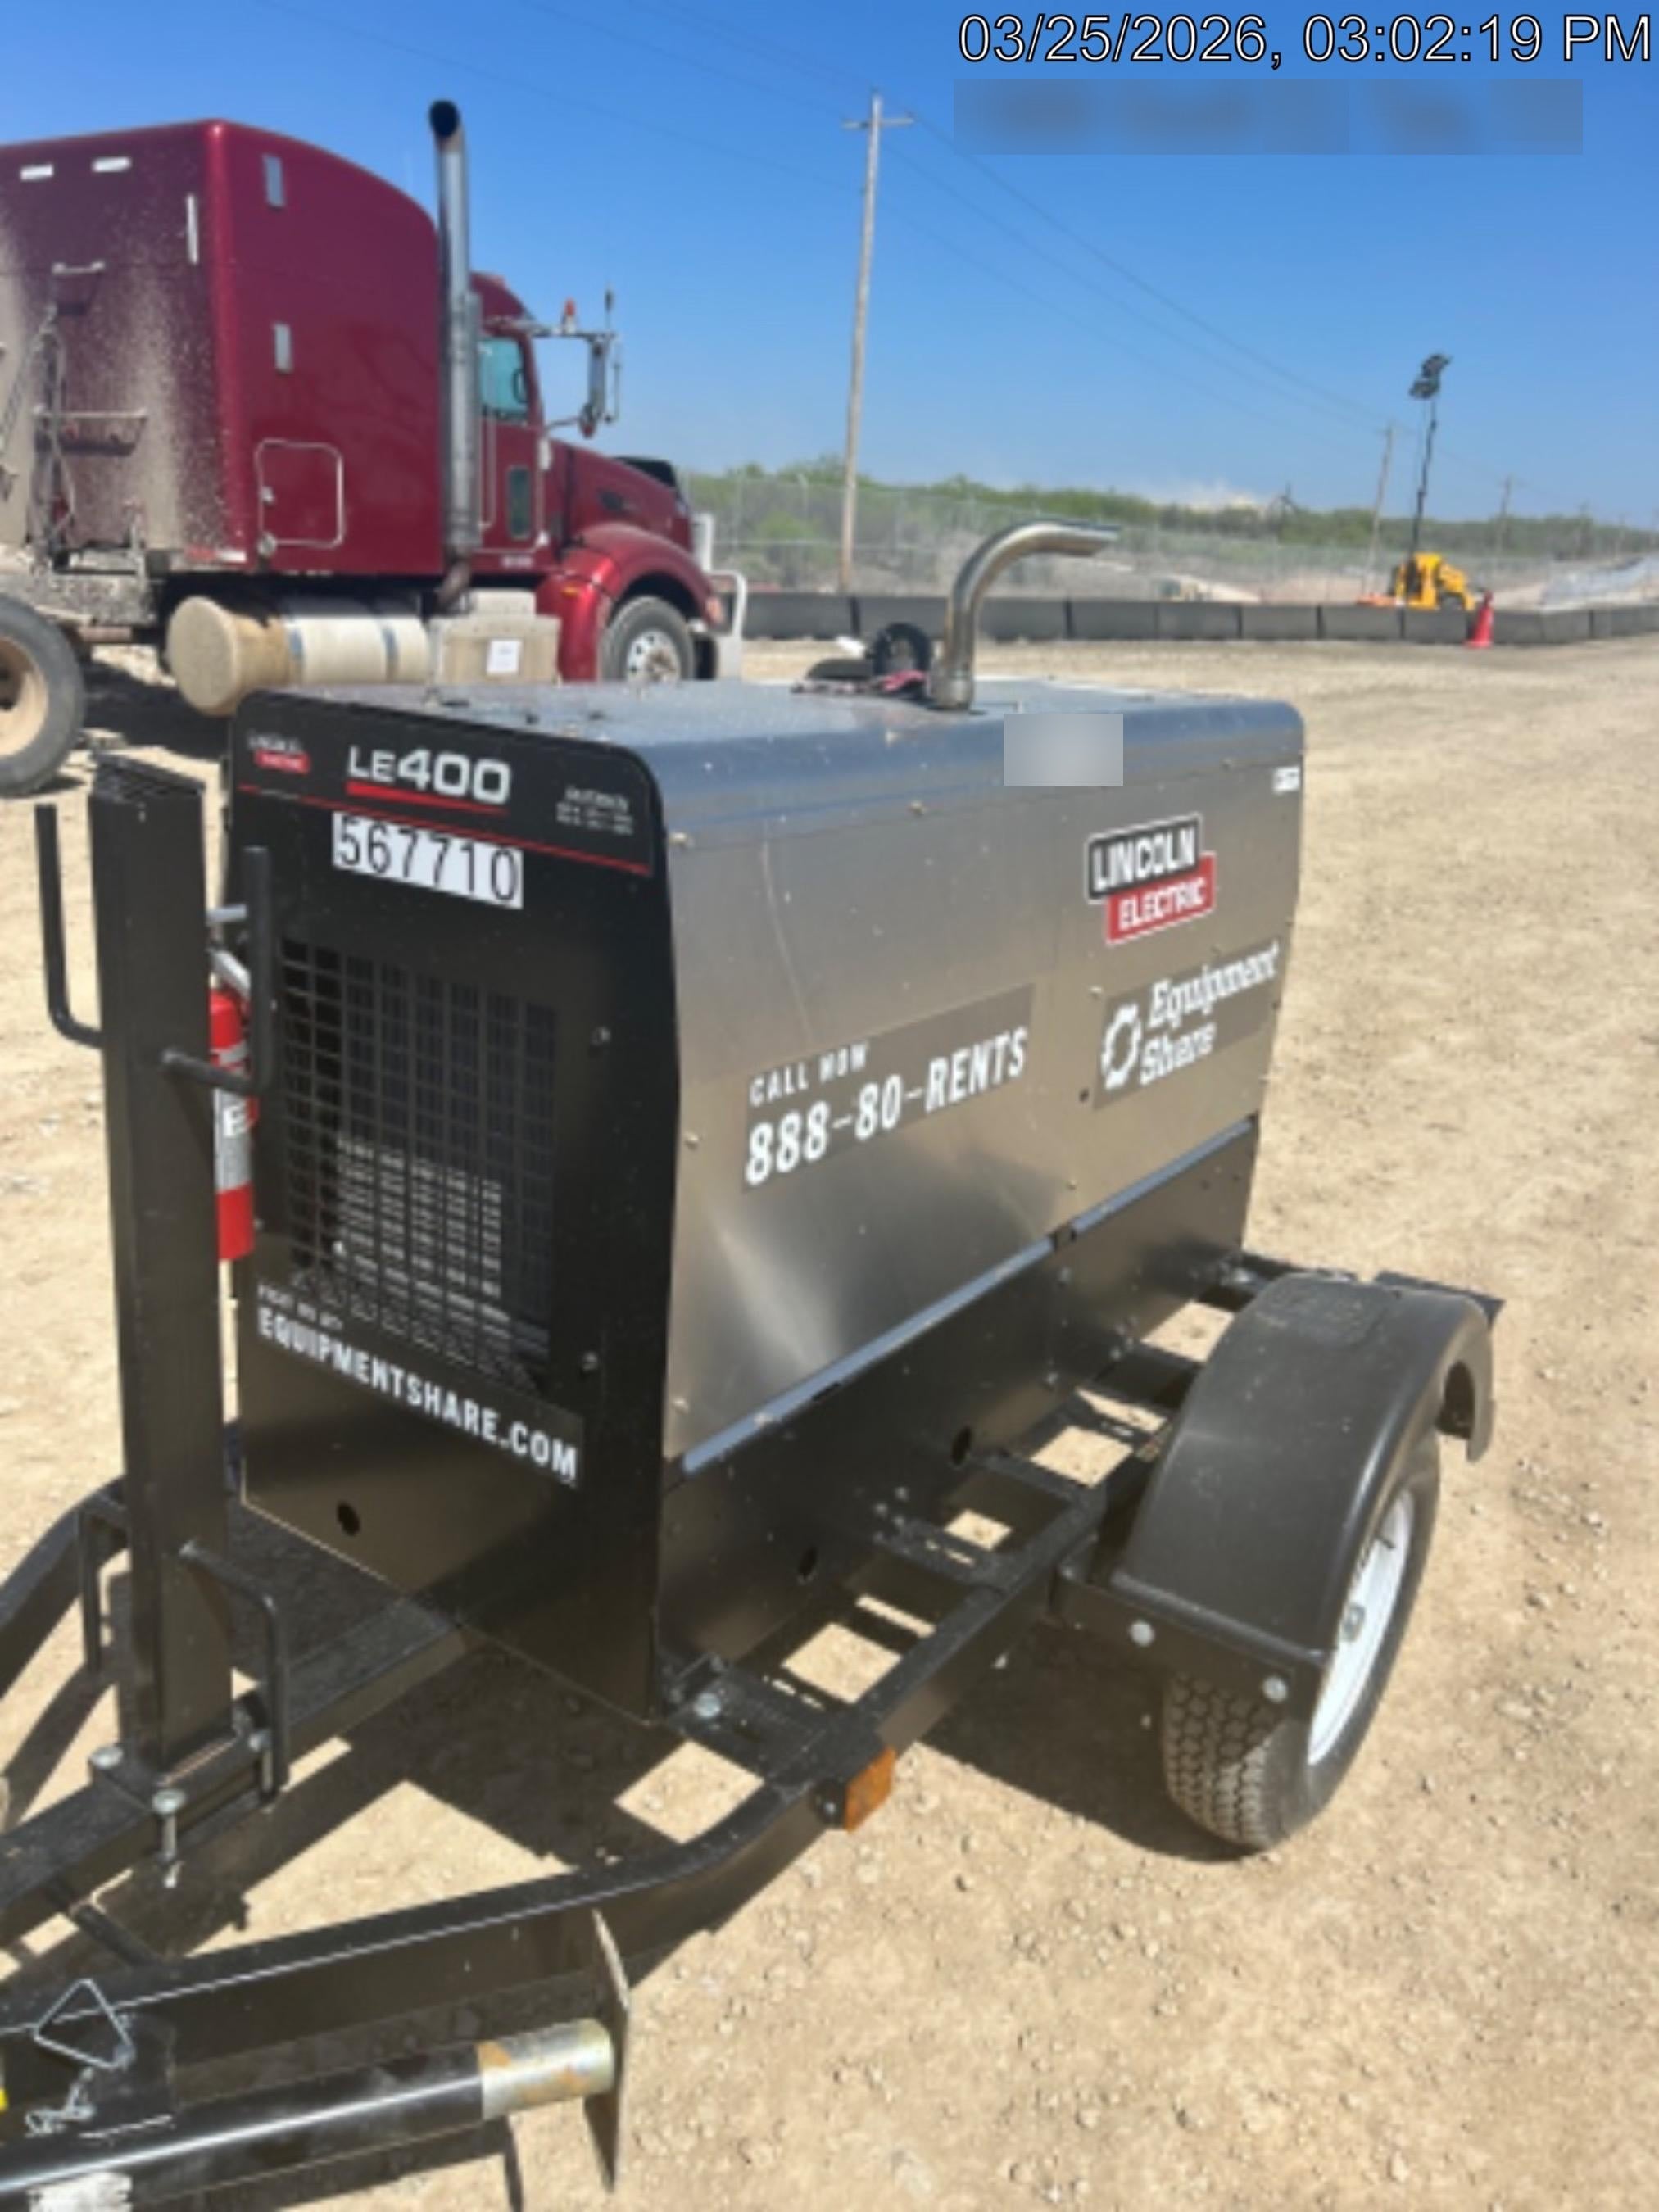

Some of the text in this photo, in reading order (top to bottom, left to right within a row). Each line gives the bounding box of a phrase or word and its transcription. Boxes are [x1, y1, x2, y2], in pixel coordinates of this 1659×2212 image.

[347, 744, 511, 805] LE400
[337, 814, 519, 903] 567710
[1093, 827, 1195, 892] LINCOLN
[1117, 877, 1206, 931] ELECTRIC
[1149, 940, 1280, 1030] Equipment
[749, 1039, 869, 1107] CALL NOW
[1140, 1022, 1217, 1086] Share
[745, 1025, 1028, 1185] 888-80-RENTS
[257, 1306, 578, 1483] EQUIPMENTSHARE.COM
